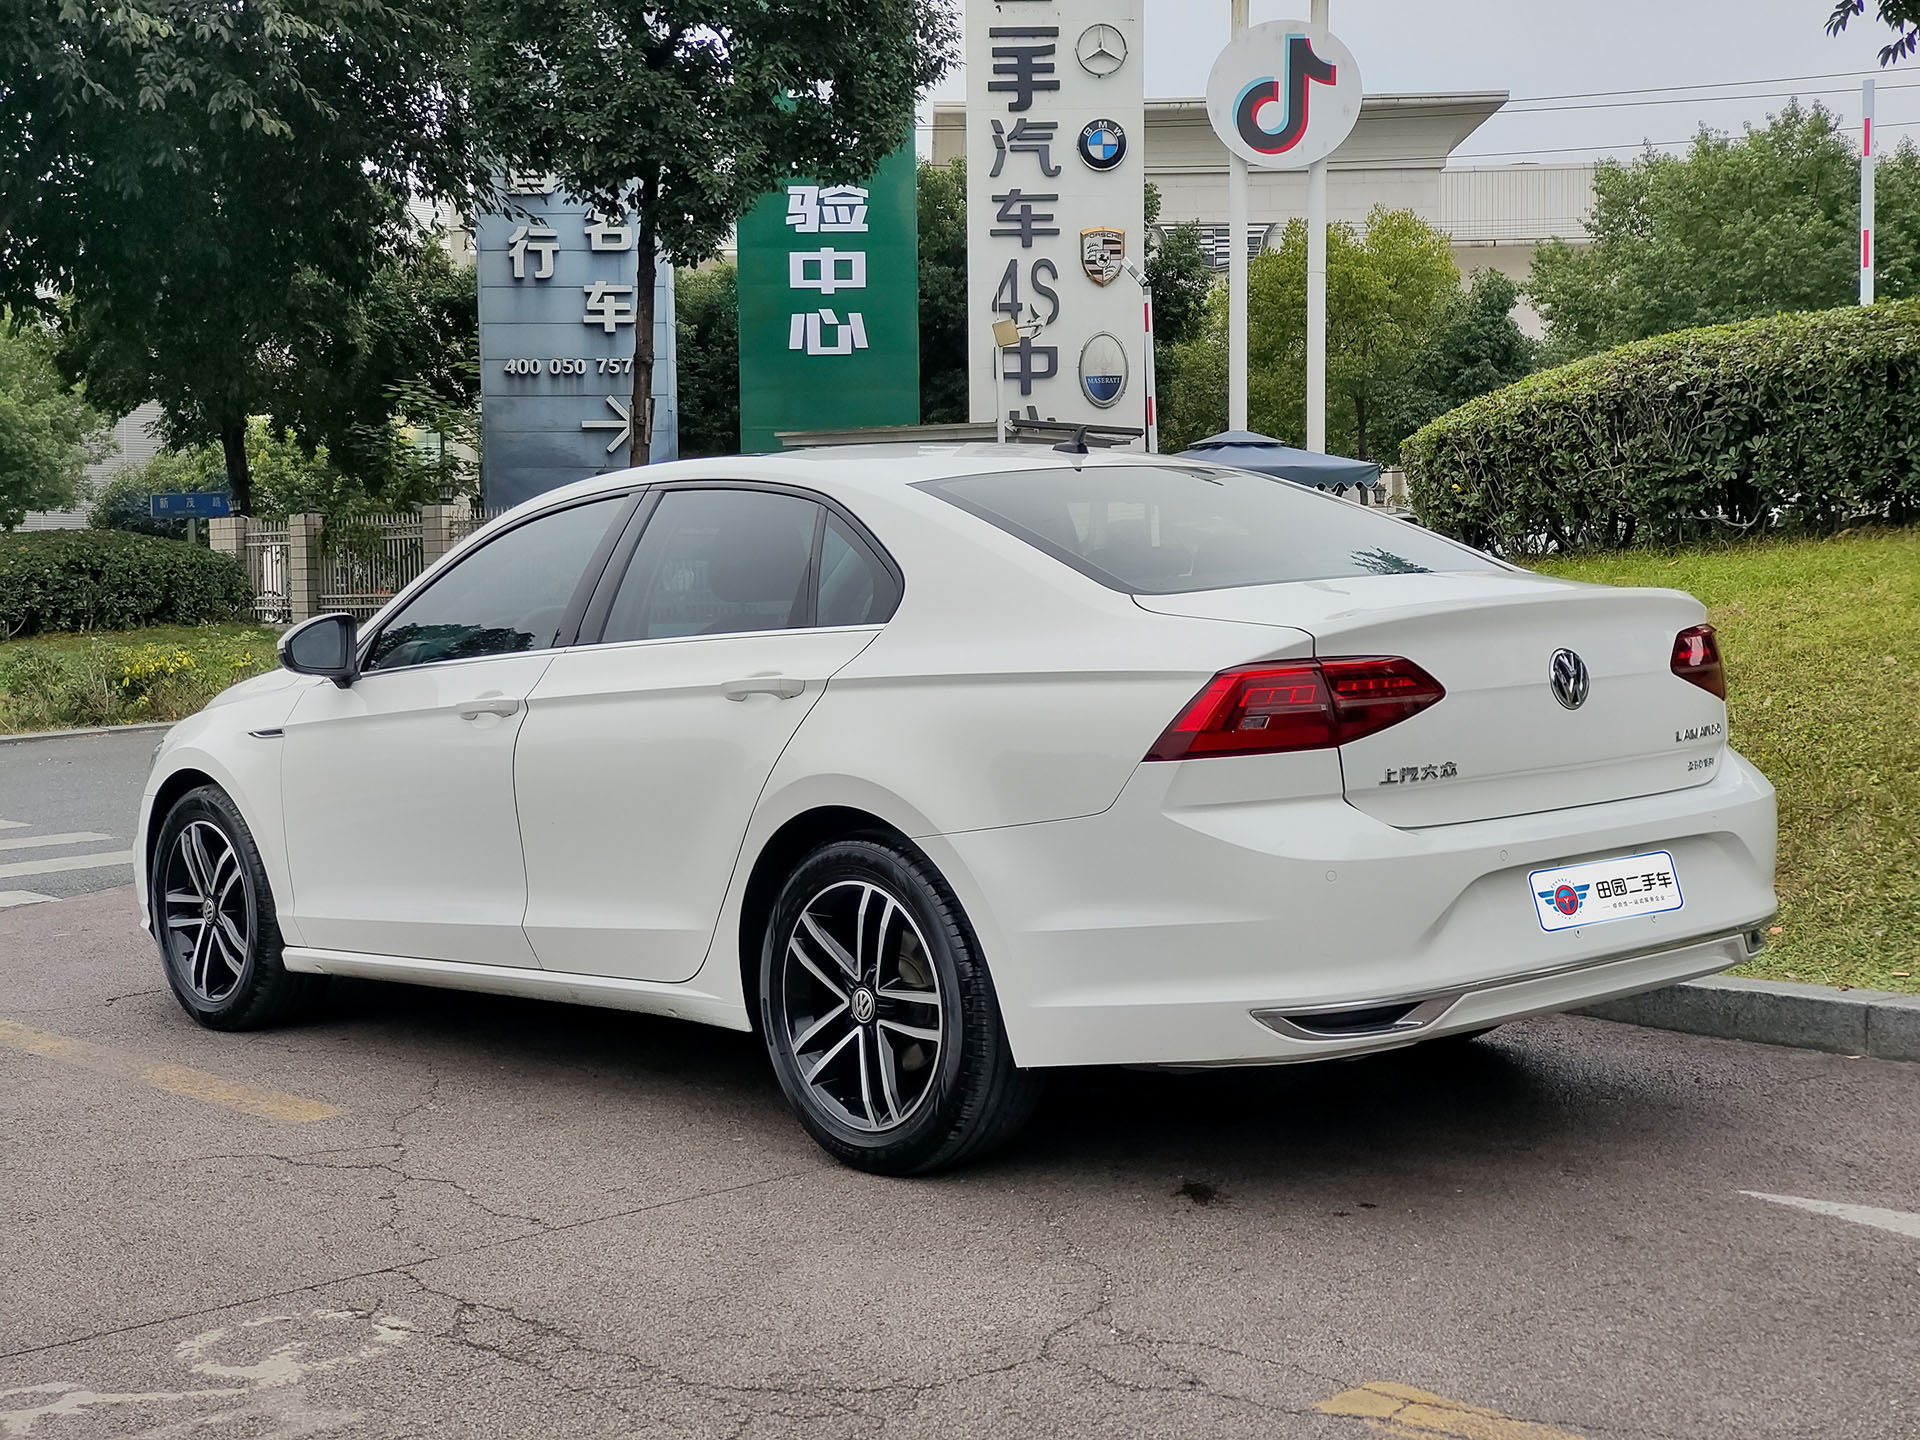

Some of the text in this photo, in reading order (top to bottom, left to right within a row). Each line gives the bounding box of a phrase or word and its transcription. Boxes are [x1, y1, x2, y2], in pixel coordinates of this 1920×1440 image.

[1083, 120, 1123, 137] BMW
[785, 184, 869, 356] 验中心
[503, 358, 542, 375] 400
[549, 358, 588, 375] 050
[1379, 761, 1458, 786] 上汽大众
[1595, 871, 1673, 899] 田园二手车
